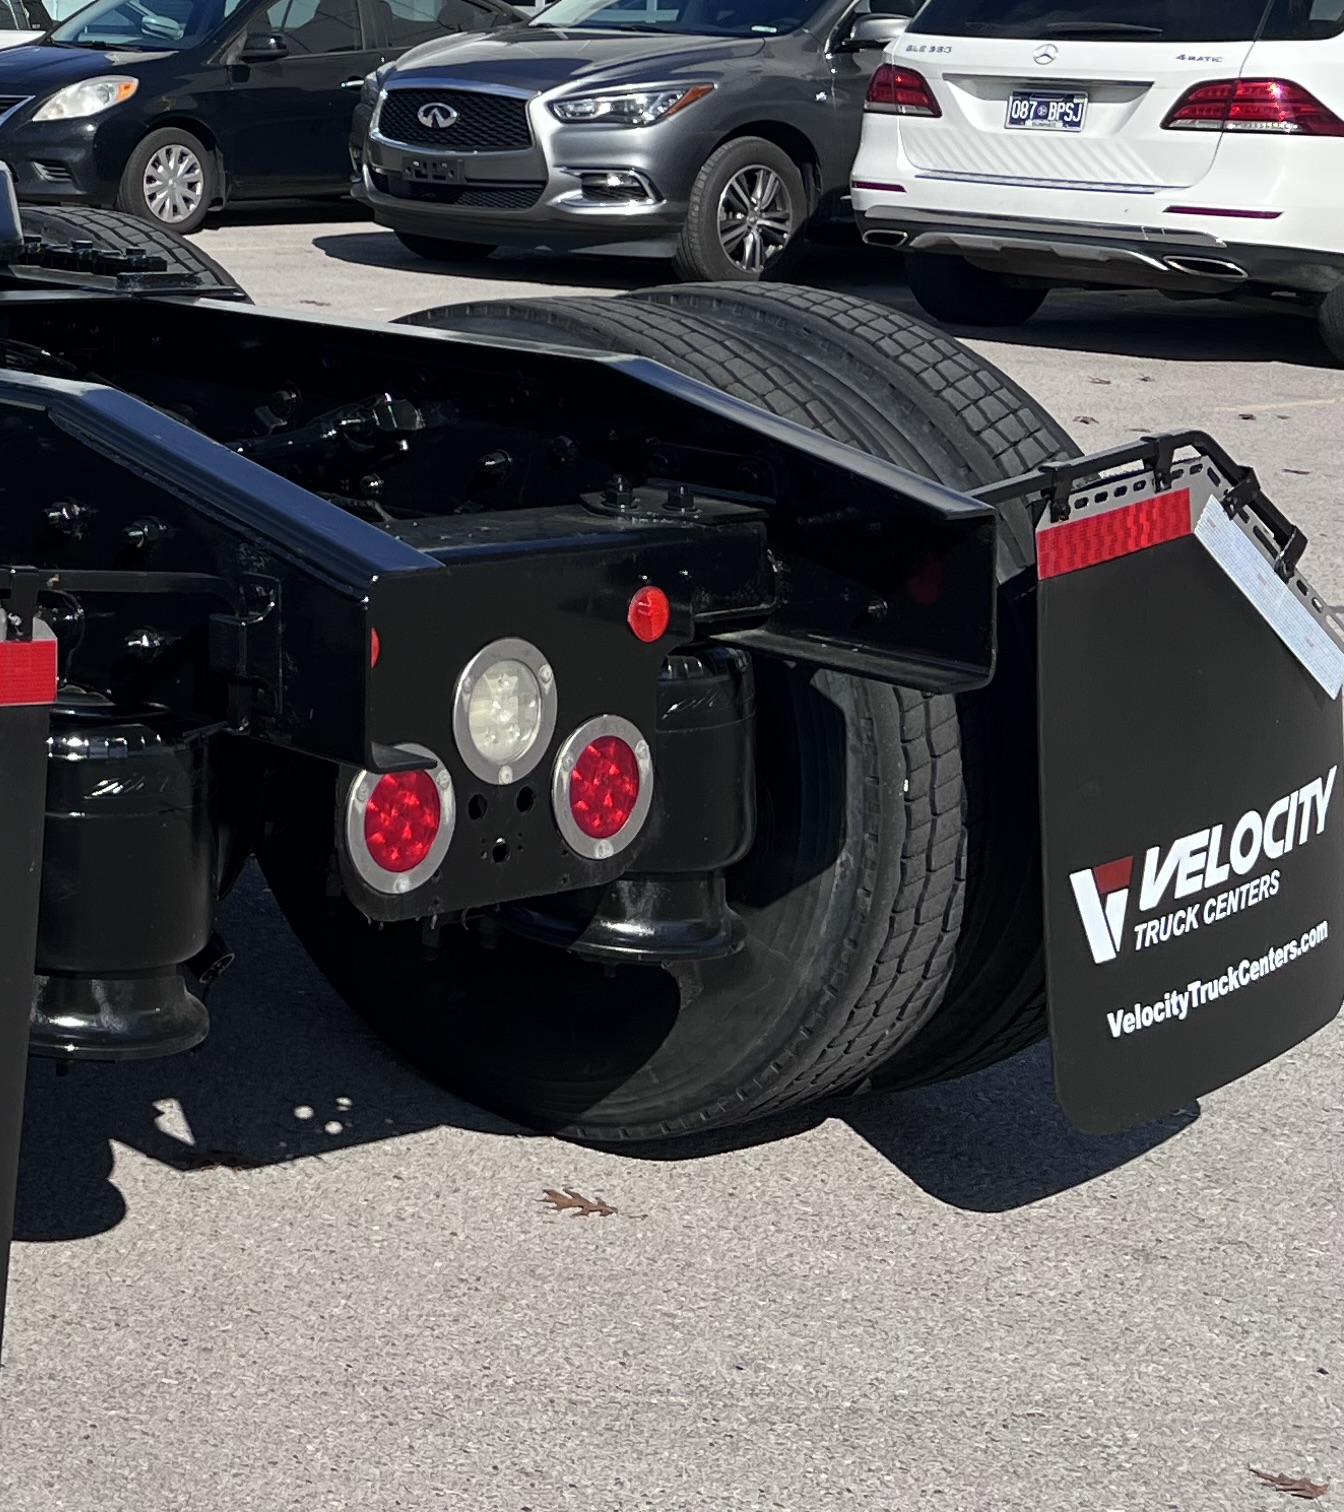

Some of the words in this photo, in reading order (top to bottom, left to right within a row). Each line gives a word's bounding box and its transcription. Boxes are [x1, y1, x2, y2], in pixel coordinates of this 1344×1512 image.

[1011, 100, 1038, 119] 087
[1047, 102, 1083, 122] BPSJ
[1139, 765, 1338, 912] VELOCITY
[1134, 903, 1200, 952] TRUCK
[1203, 869, 1281, 925] CENTERS
[1107, 920, 1329, 1038] VelocityTruckCenters.com
